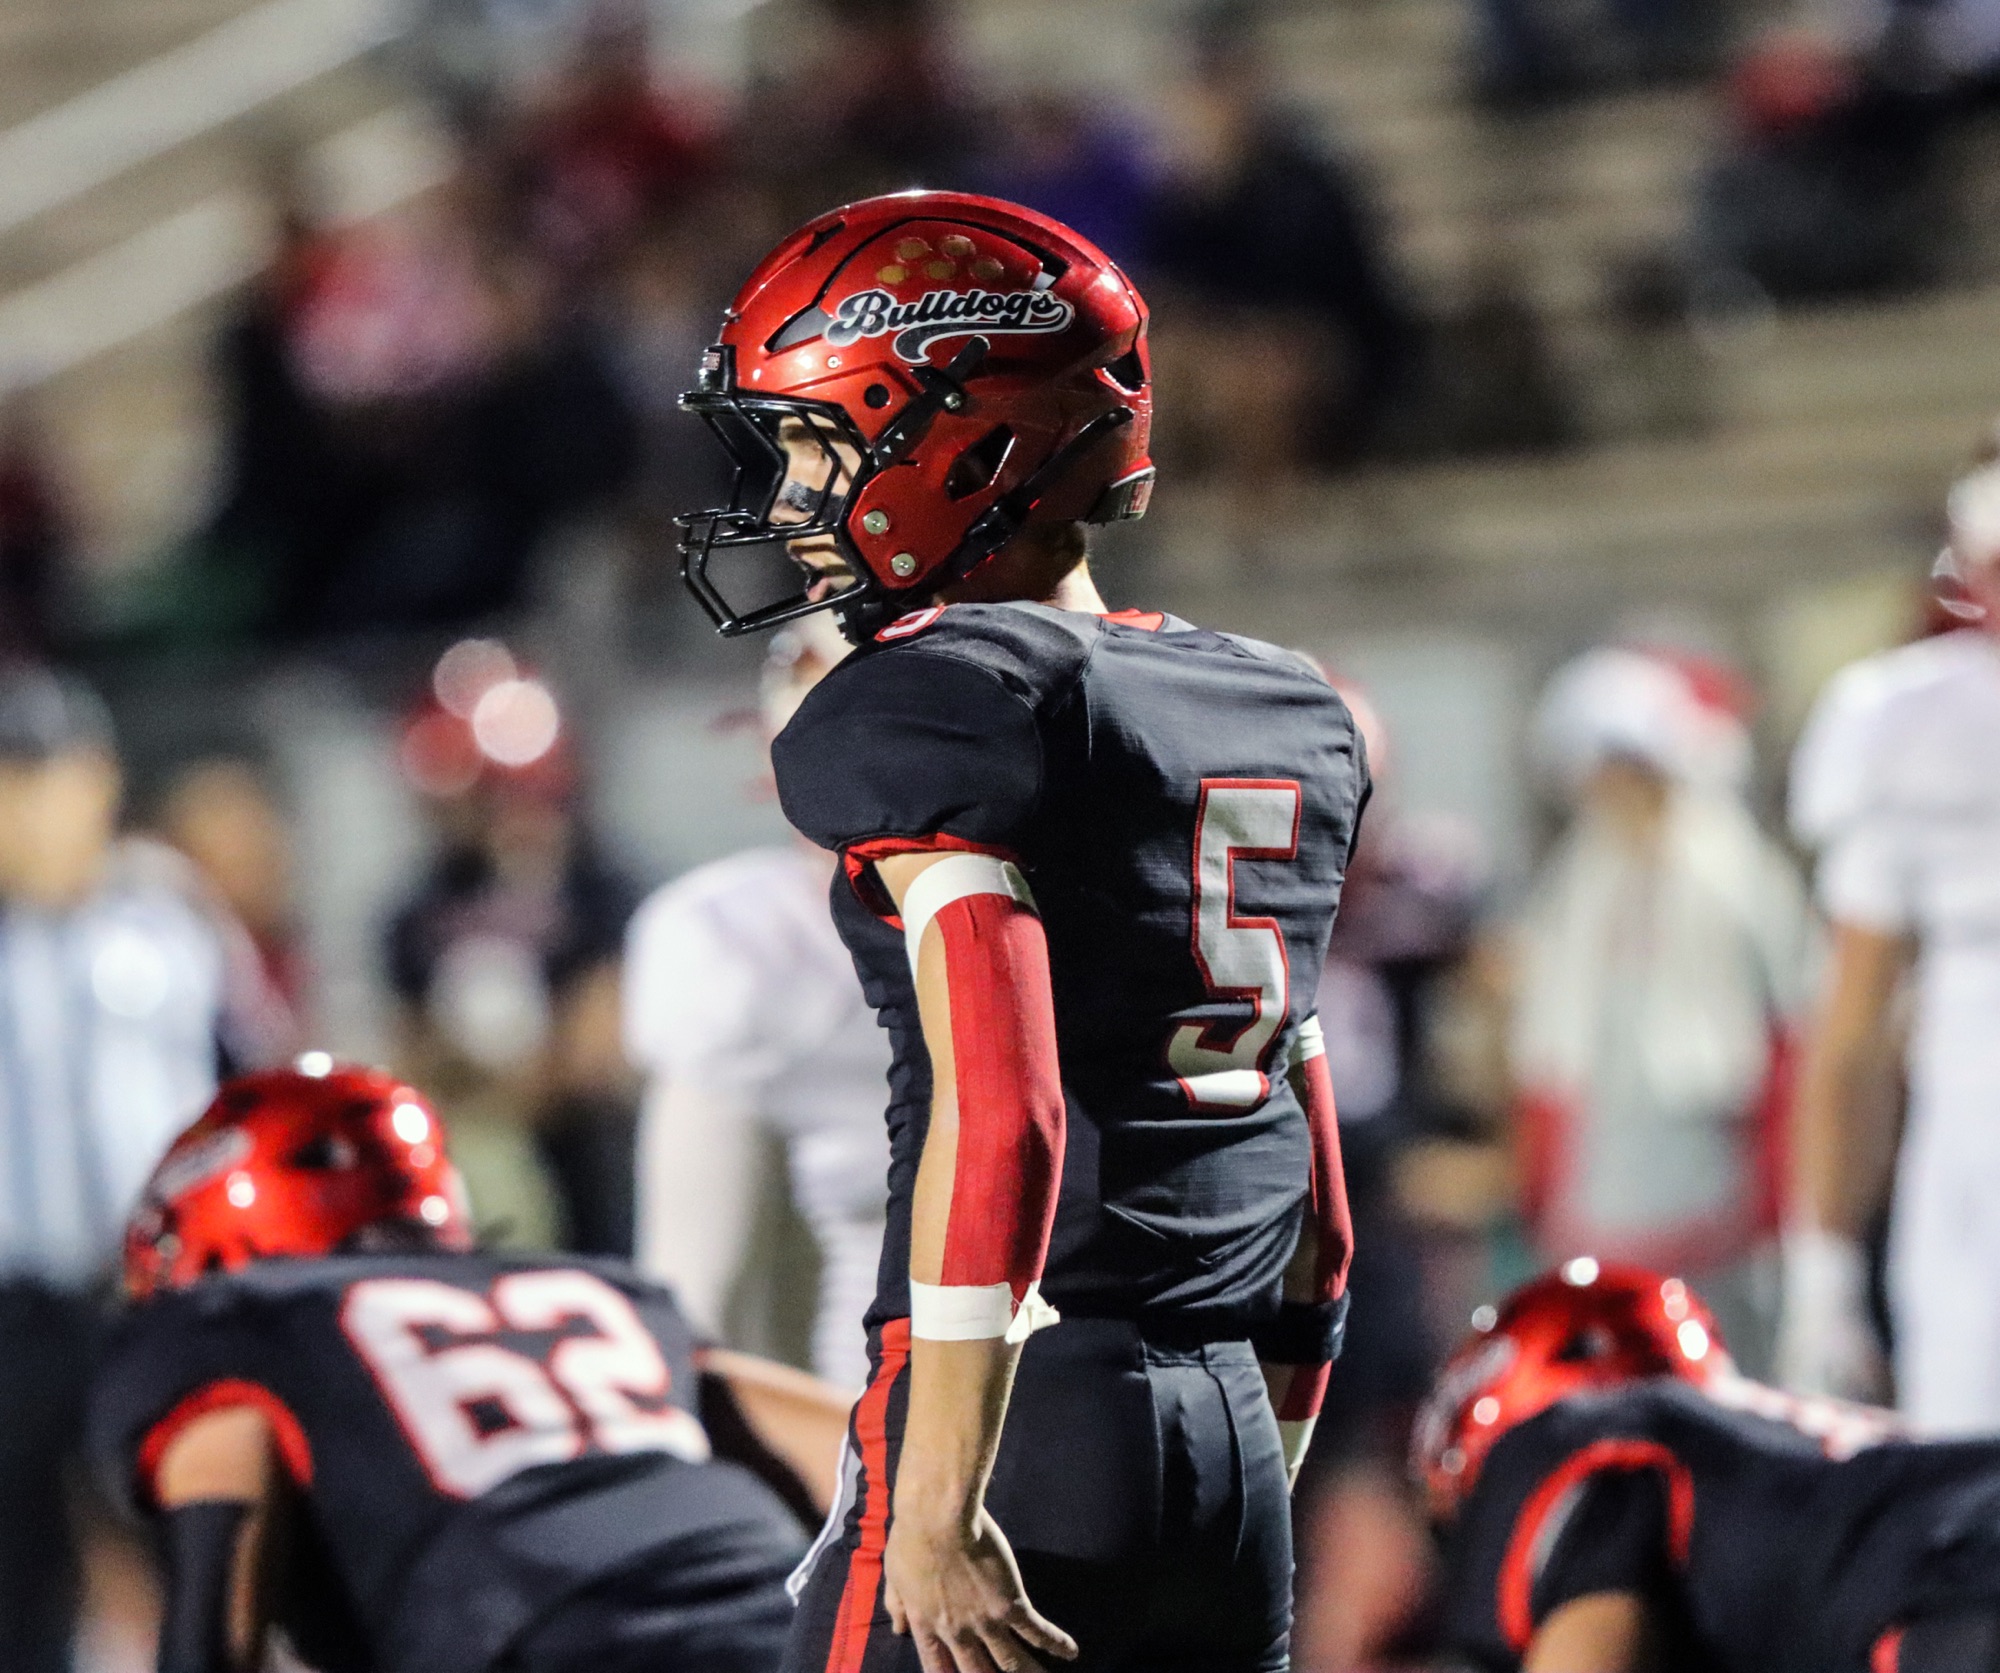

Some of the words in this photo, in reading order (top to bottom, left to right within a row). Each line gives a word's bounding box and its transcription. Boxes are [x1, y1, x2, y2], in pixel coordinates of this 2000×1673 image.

[825, 288, 1074, 364] Bulldogs
[1165, 778, 1301, 1111] 5
[338, 1269, 712, 1500] 62
